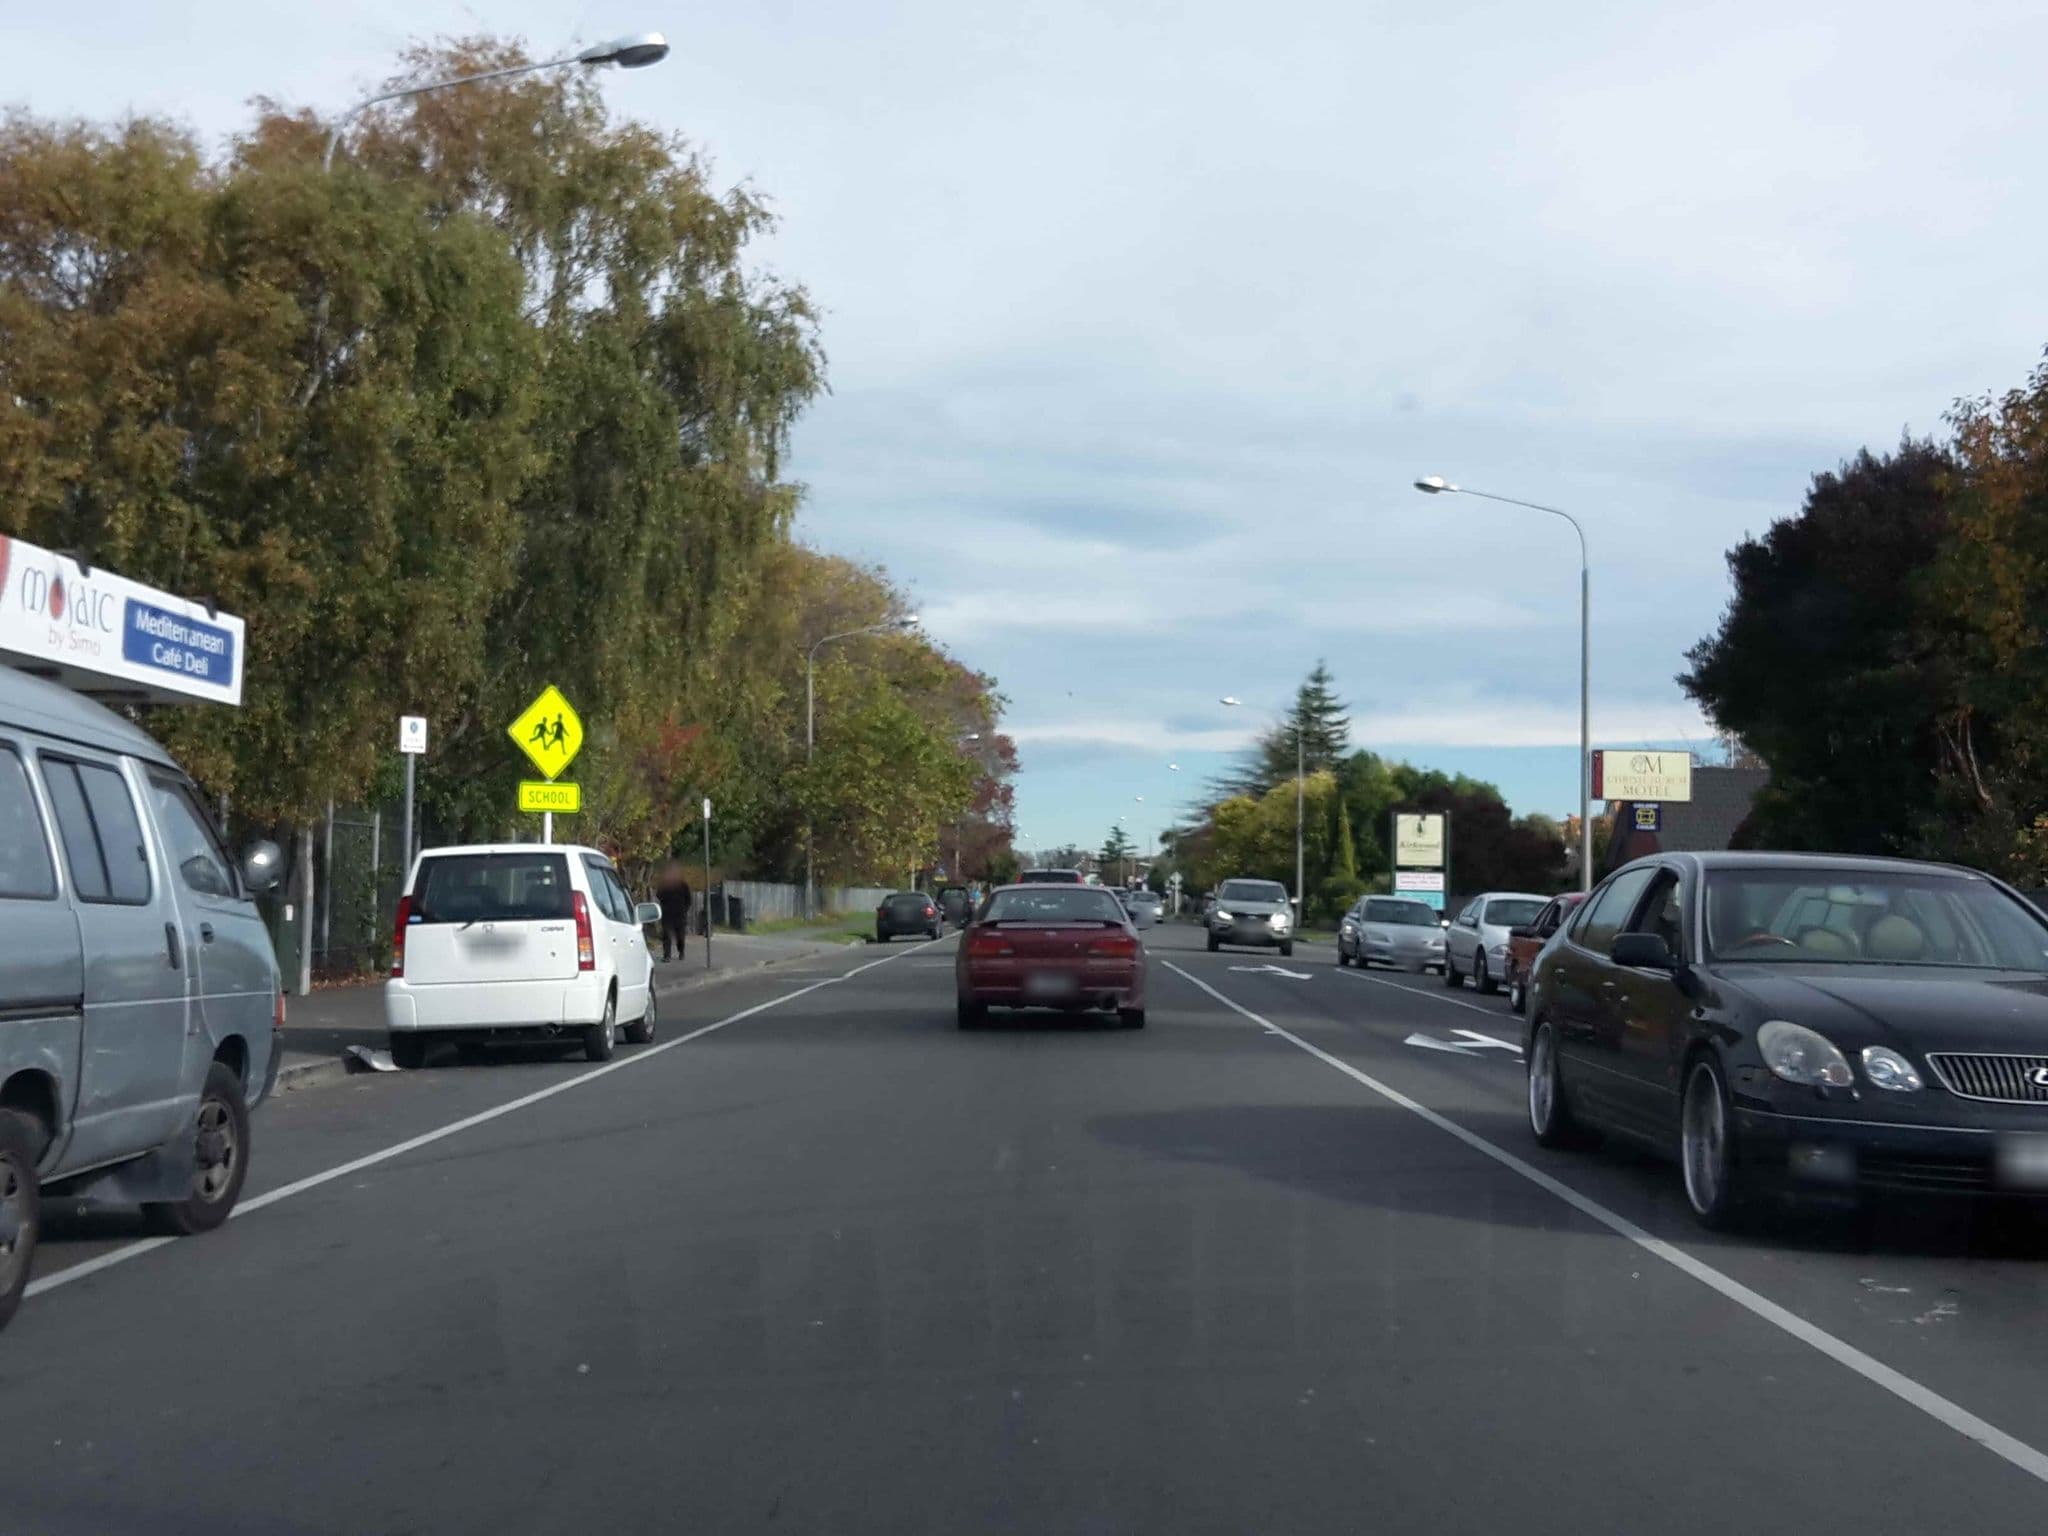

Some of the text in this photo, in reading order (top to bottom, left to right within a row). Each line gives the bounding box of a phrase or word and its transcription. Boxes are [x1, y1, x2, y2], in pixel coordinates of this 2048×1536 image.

[48, 625, 64, 650] by
[135, 608, 224, 655] Mediterranean
[185, 652, 209, 676] Deli
[528, 790, 571, 804] SCHOOL
[1623, 785, 1671, 797] MOTEL
